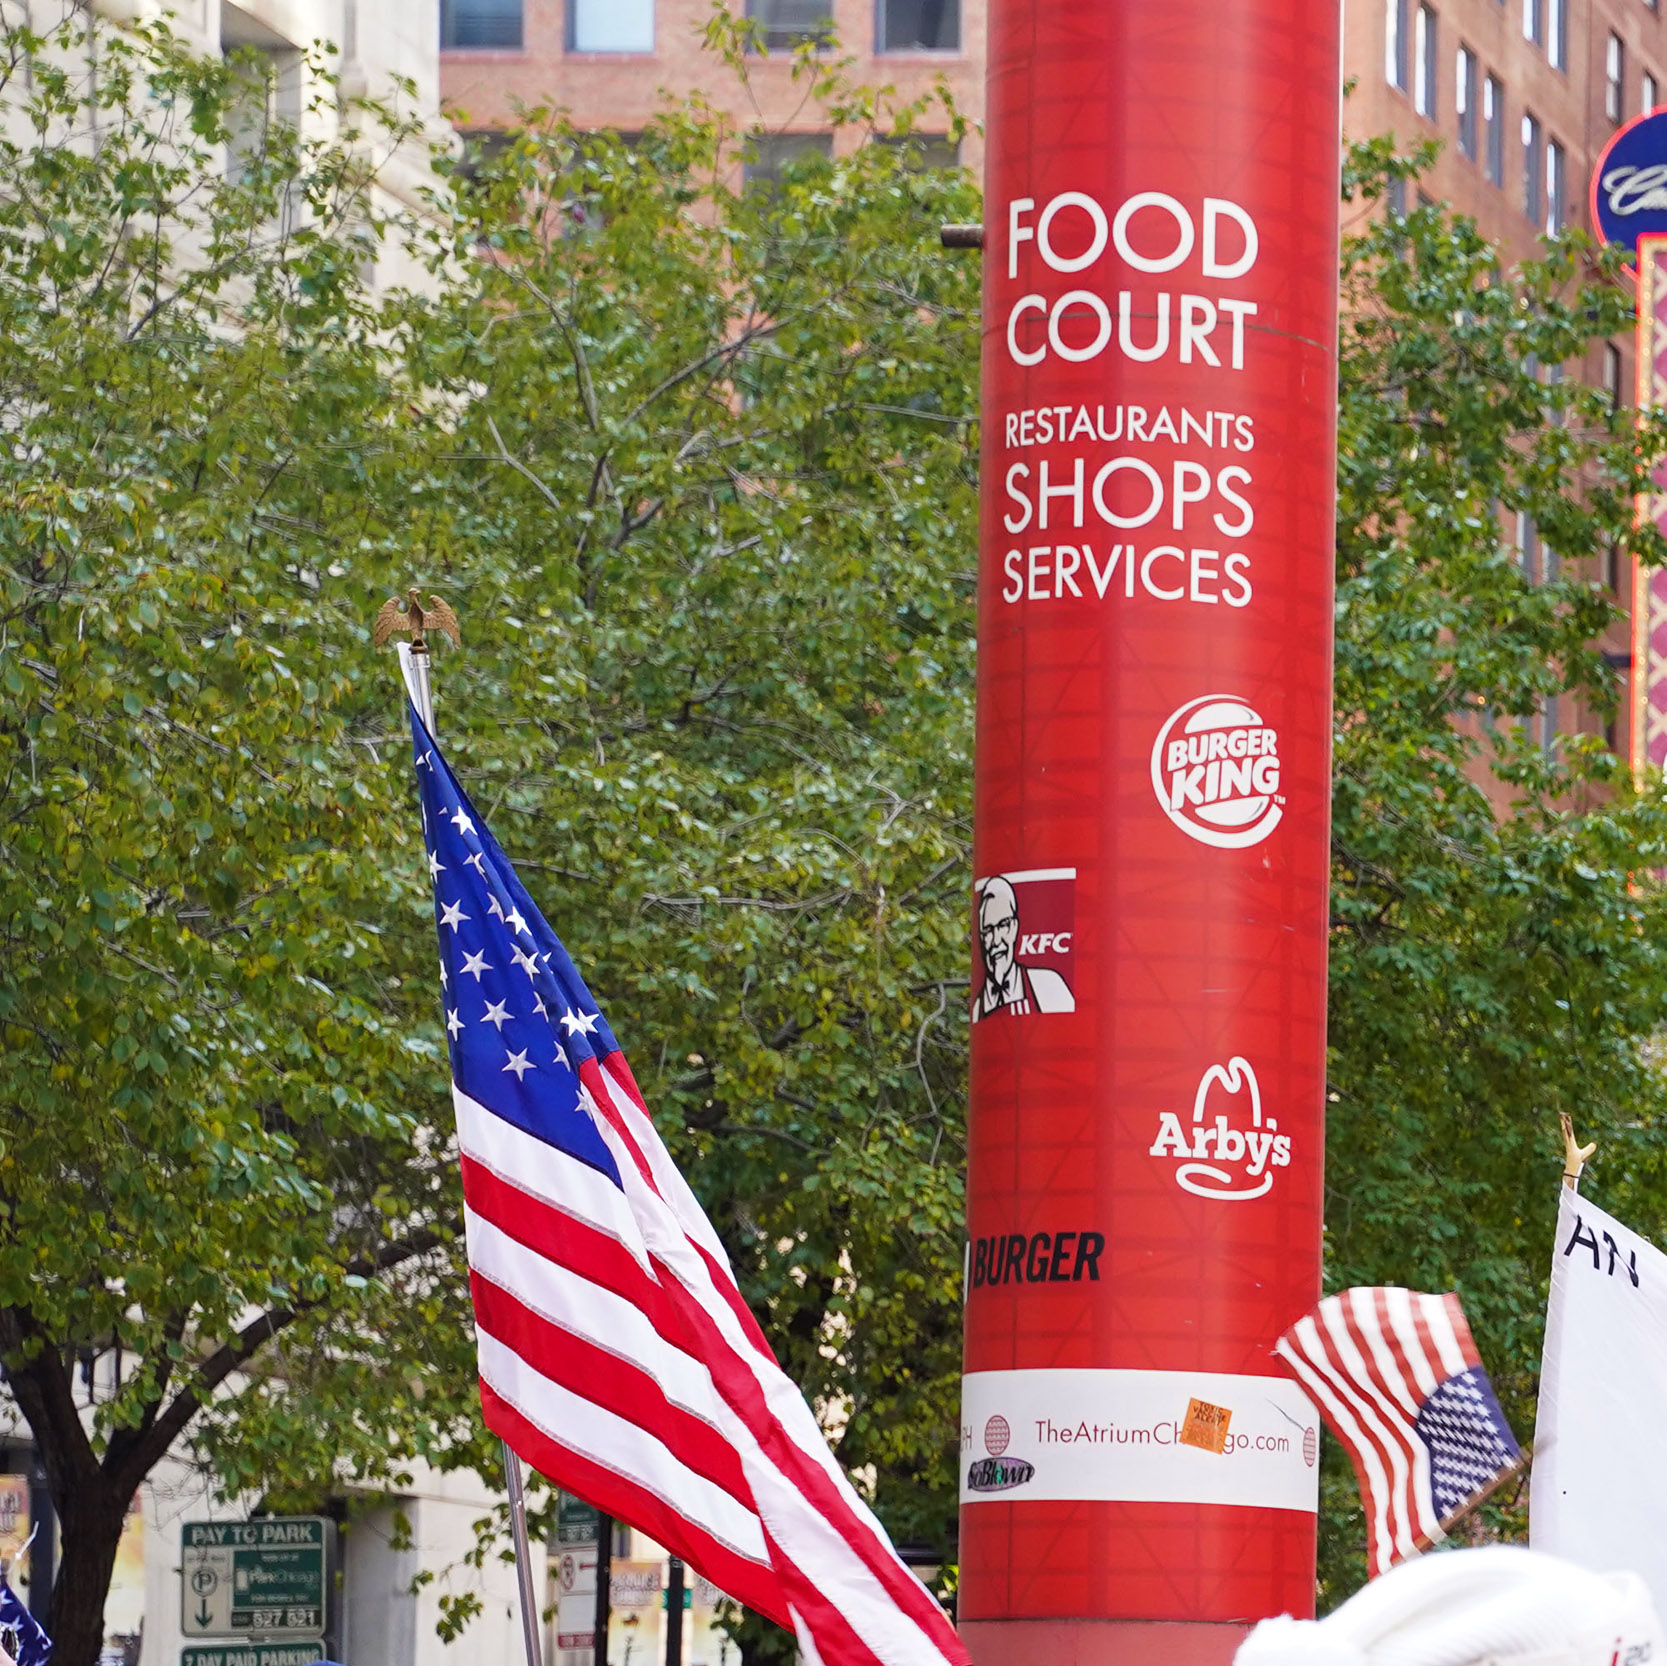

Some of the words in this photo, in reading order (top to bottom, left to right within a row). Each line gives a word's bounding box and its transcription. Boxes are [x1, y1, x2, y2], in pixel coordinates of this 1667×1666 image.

[1008, 191, 1259, 279] FOOD
[1007, 290, 1258, 370] COURT
[1005, 405, 1255, 452] RESTAURANTS
[1003, 457, 1255, 537] SHOPS
[1002, 544, 1253, 607] SERVICES
[1167, 728, 1278, 772] BURGER
[1170, 755, 1280, 812] KING
[1019, 932, 1072, 956] KFC
[1150, 1112, 1291, 1176] Arby's
[972, 1232, 1105, 1289] BURGER
[1035, 1419, 1289, 1454] TheAtriumChgo.com
[191, 1525, 227, 1544] PAY
[233, 1525, 258, 1543] TO
[262, 1524, 313, 1542] PARK
